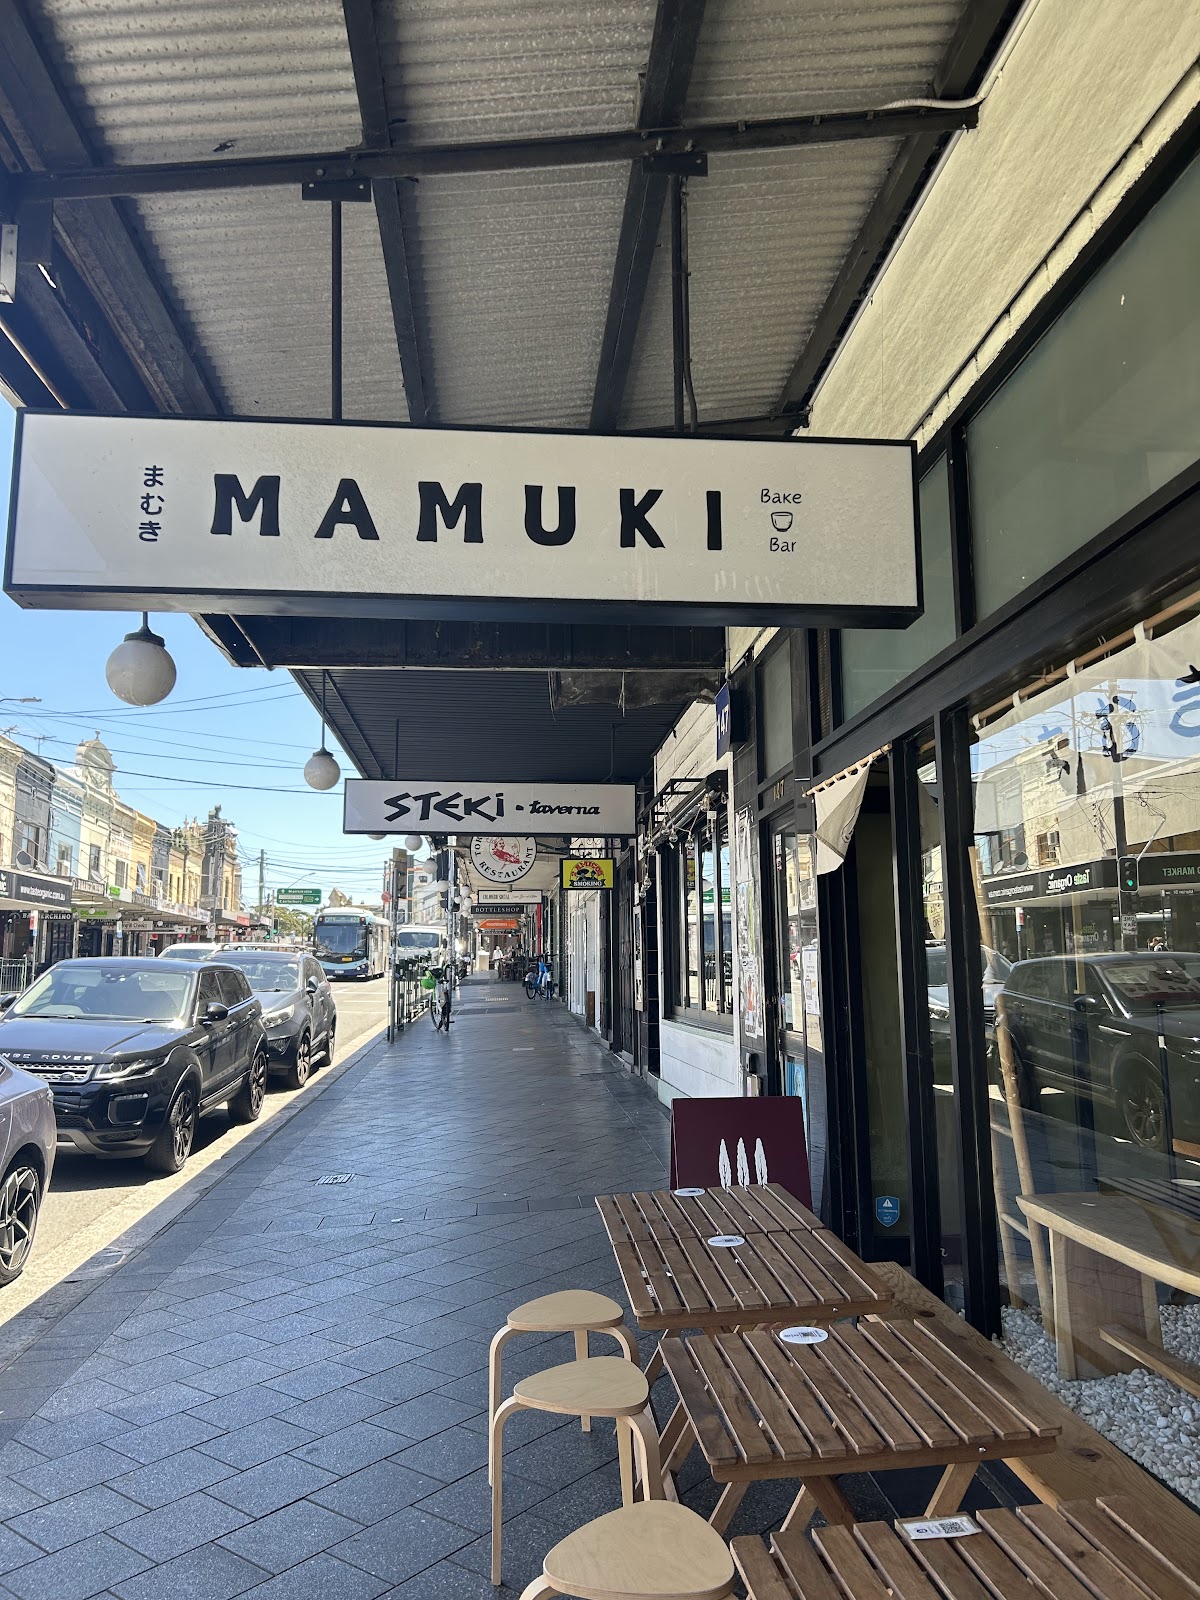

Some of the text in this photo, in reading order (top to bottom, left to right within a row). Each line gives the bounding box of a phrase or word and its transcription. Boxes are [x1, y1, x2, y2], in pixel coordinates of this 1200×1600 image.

[138, 465, 165, 543] まむき
[760, 488, 802, 505] Bake
[210, 474, 723, 551] MAMUKI
[769, 537, 797, 553] Bar
[716, 706, 731, 741] 147
[529, 800, 601, 815] taverna
[479, 847, 534, 878] RESTAURANT
